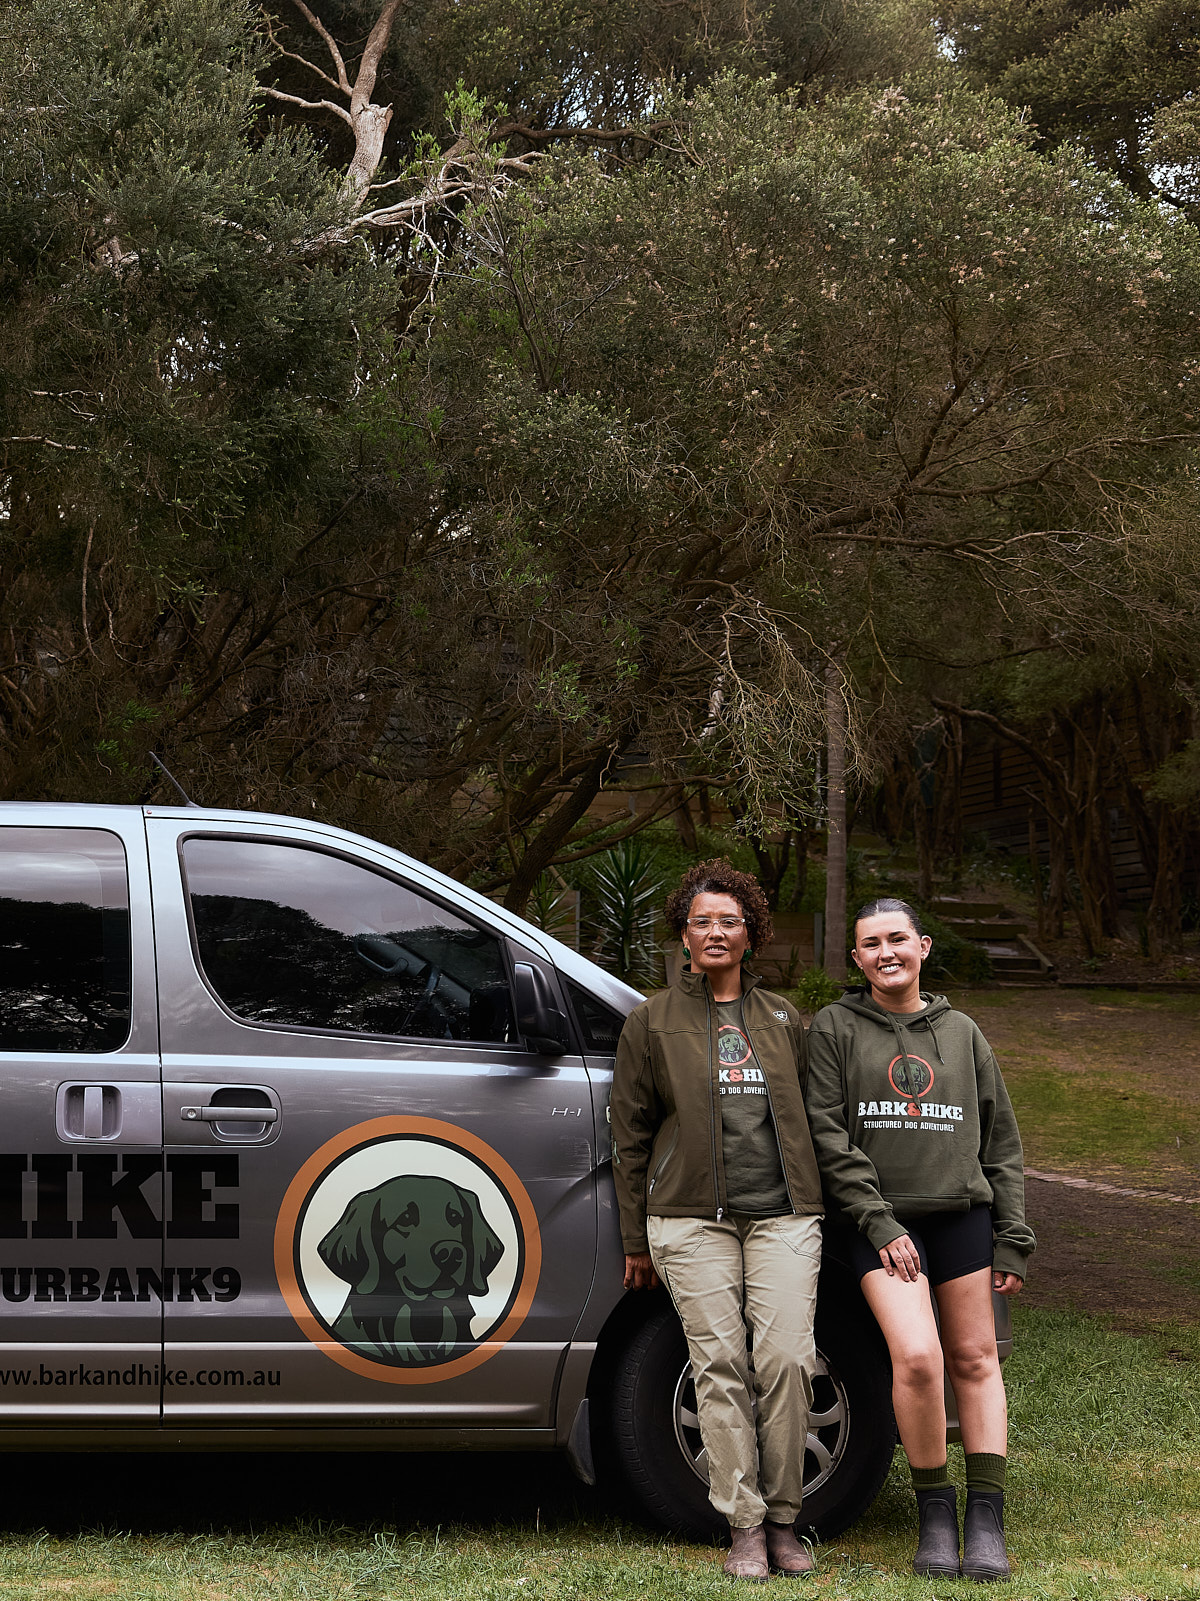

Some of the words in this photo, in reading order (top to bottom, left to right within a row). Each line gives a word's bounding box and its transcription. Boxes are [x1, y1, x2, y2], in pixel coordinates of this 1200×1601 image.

[728, 1086, 741, 1094] DOG
[858, 1101, 963, 1120] BARK&HIKE
[863, 1120, 902, 1129] STRUCTURED
[904, 1121, 918, 1130] DOG
[920, 1121, 954, 1132] ADVENTURES
[0, 1266, 242, 1303] URBANK9
